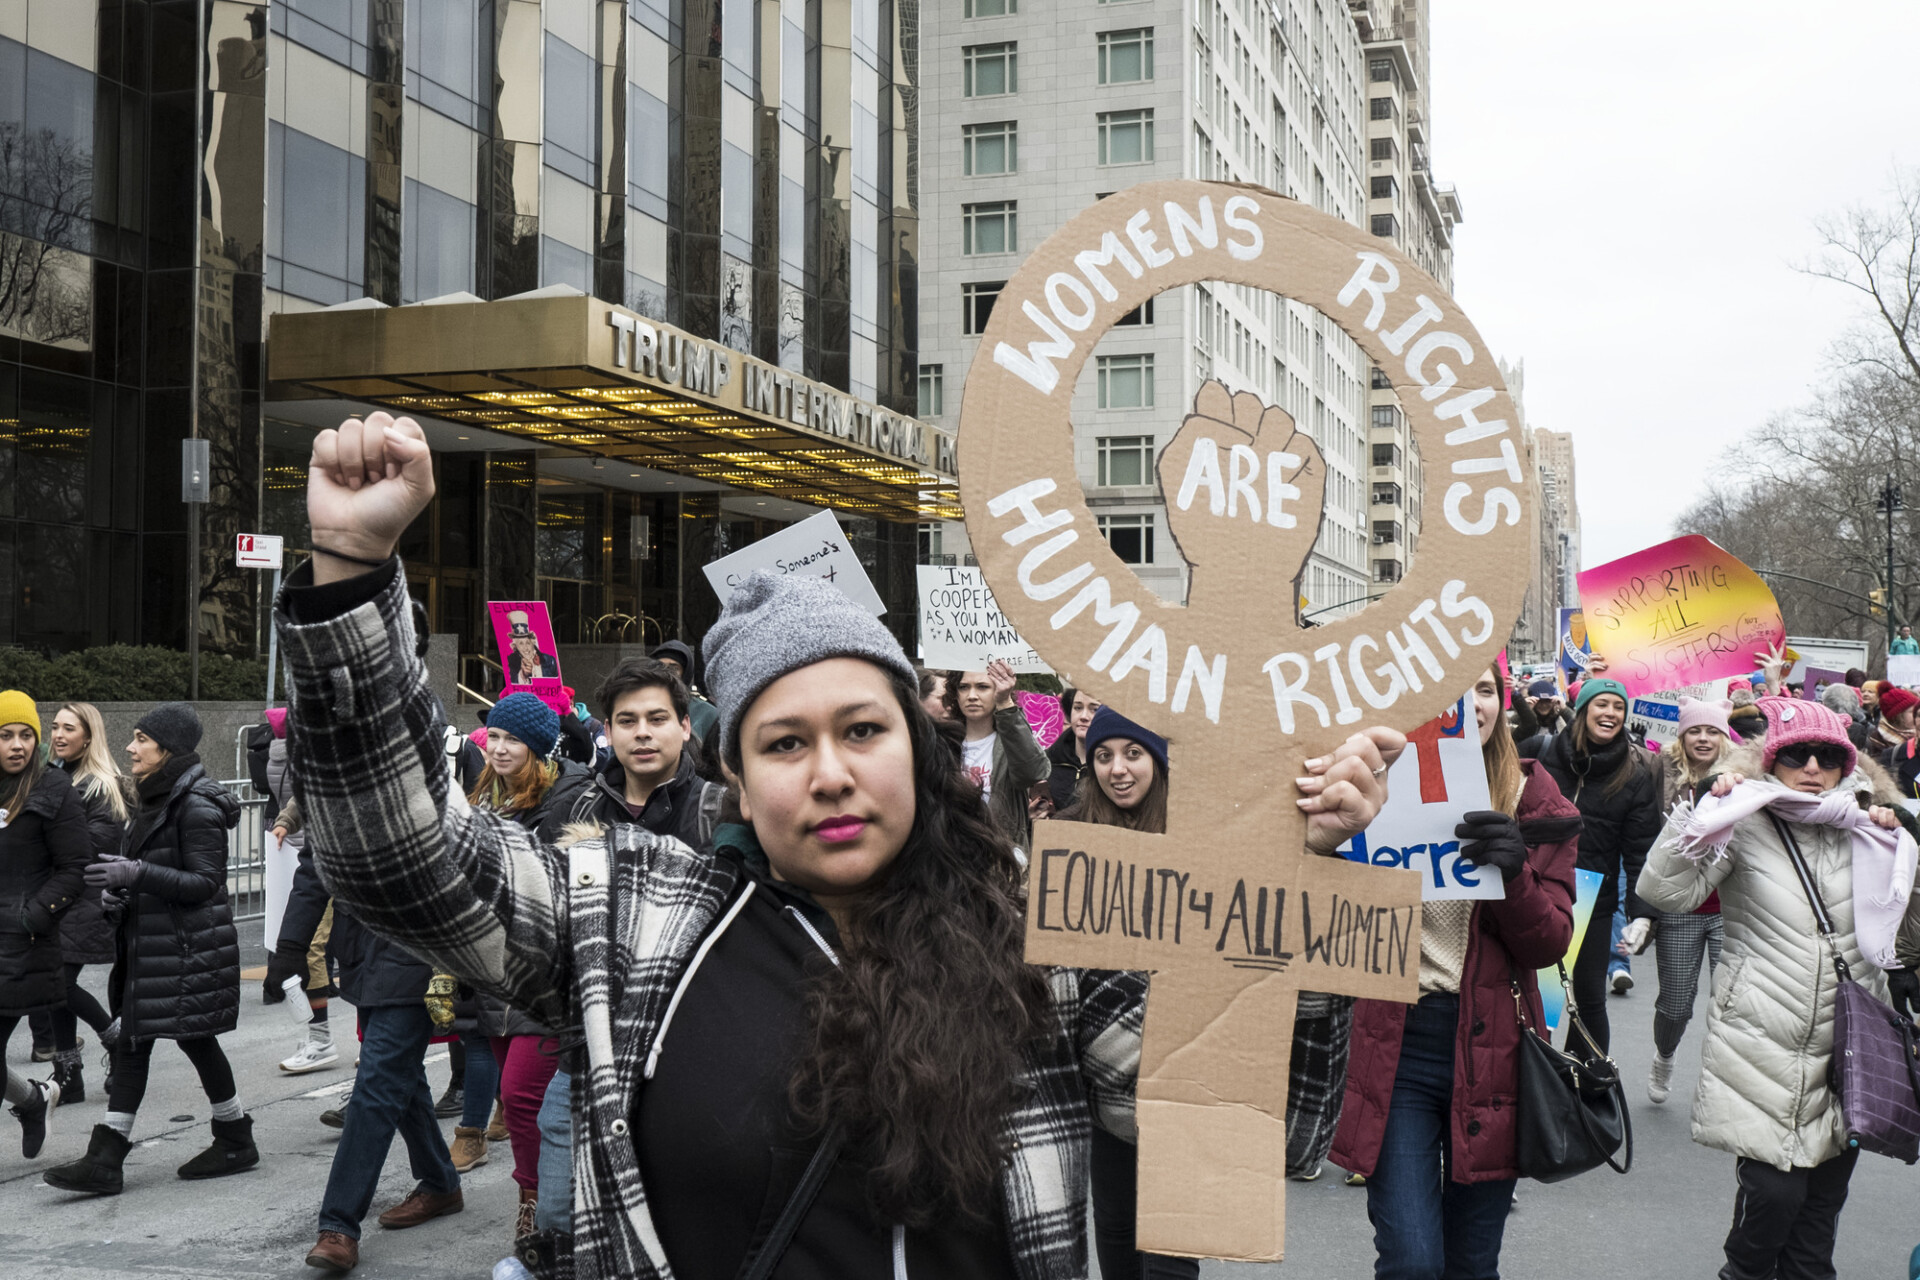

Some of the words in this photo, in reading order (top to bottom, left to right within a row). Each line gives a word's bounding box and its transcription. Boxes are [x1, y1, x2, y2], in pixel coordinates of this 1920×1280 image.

[993, 194, 1264, 396] WOMENS
[606, 311, 731, 398] TRUMP
[743, 361, 929, 466] INTERNATIONAL
[1336, 251, 1523, 536] RIGHTS
[1176, 437, 1302, 530] ARE
[493, 602, 535, 613] ELLEN
[926, 610, 945, 626] AS
[951, 611, 978, 628] YOU
[986, 477, 1227, 725] HUMAN
[1261, 579, 1495, 735] RIGHTS
[1593, 564, 1730, 631] SUPPORTING
[1648, 599, 1699, 640] ALL
[945, 627, 955, 643] A
[959, 628, 1019, 646] WOMAN
[1627, 624, 1739, 681] SISTERS
[1657, 723, 1667, 734] TO
[1037, 848, 1190, 945] EQUALITY
[1188, 887, 1214, 930] 4
[1215, 877, 1294, 960] ALL
[1301, 890, 1413, 978] WOMEN
